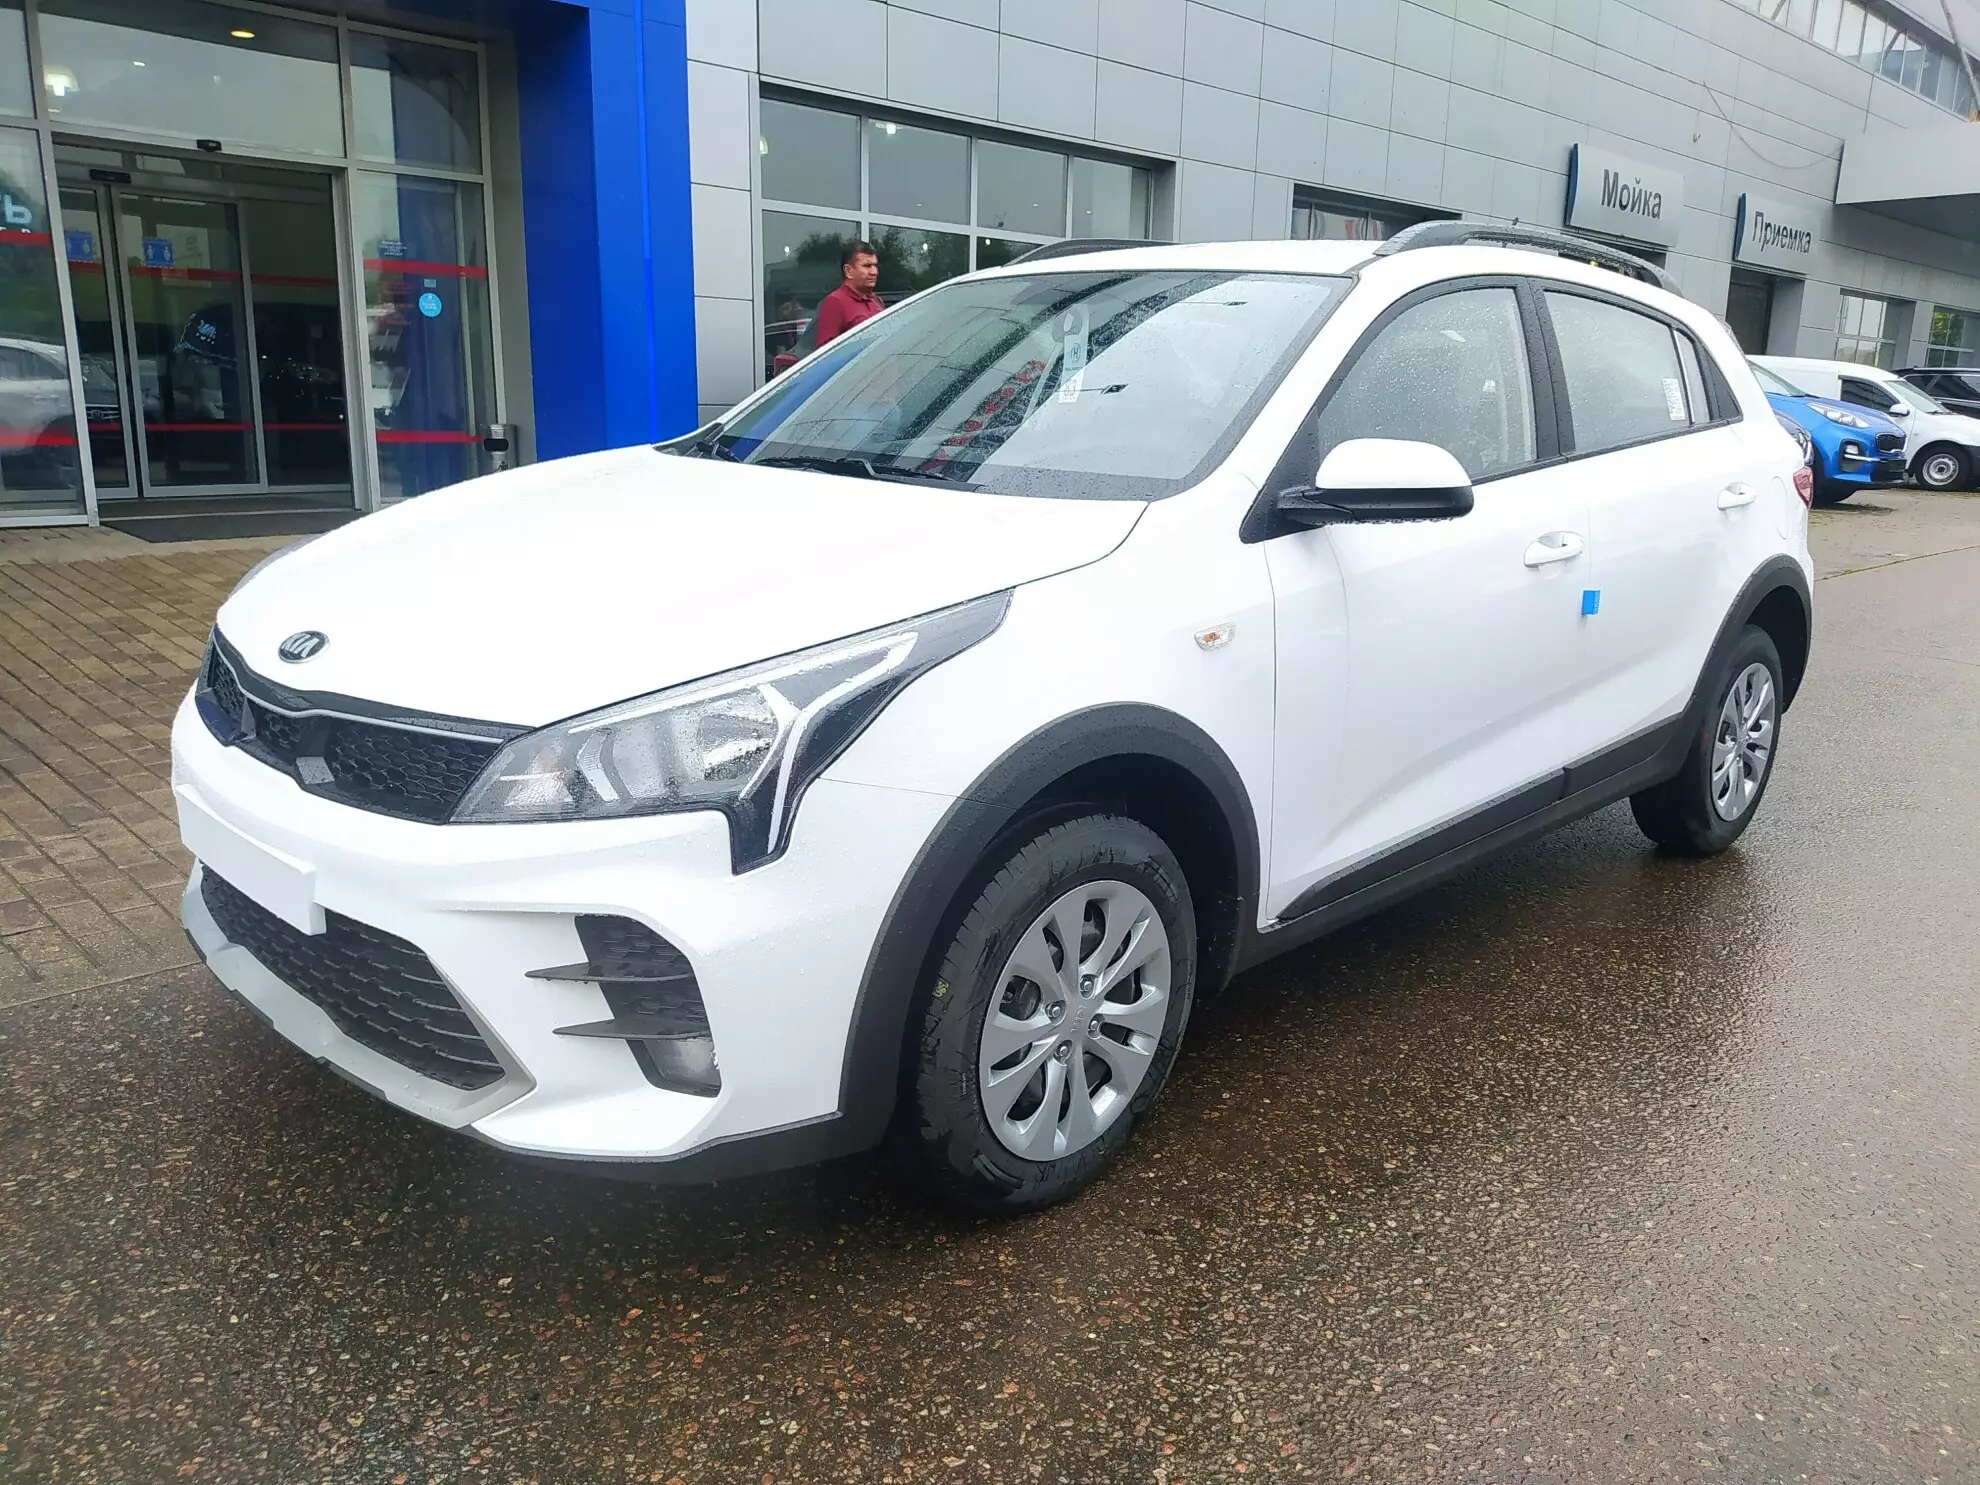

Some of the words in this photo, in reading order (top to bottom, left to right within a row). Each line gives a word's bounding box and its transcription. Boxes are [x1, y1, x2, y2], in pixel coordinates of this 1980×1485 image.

[1601, 169, 1662, 220] Мойка
[1752, 210, 1812, 254] Приемка
[281, 632, 320, 658] KIA
